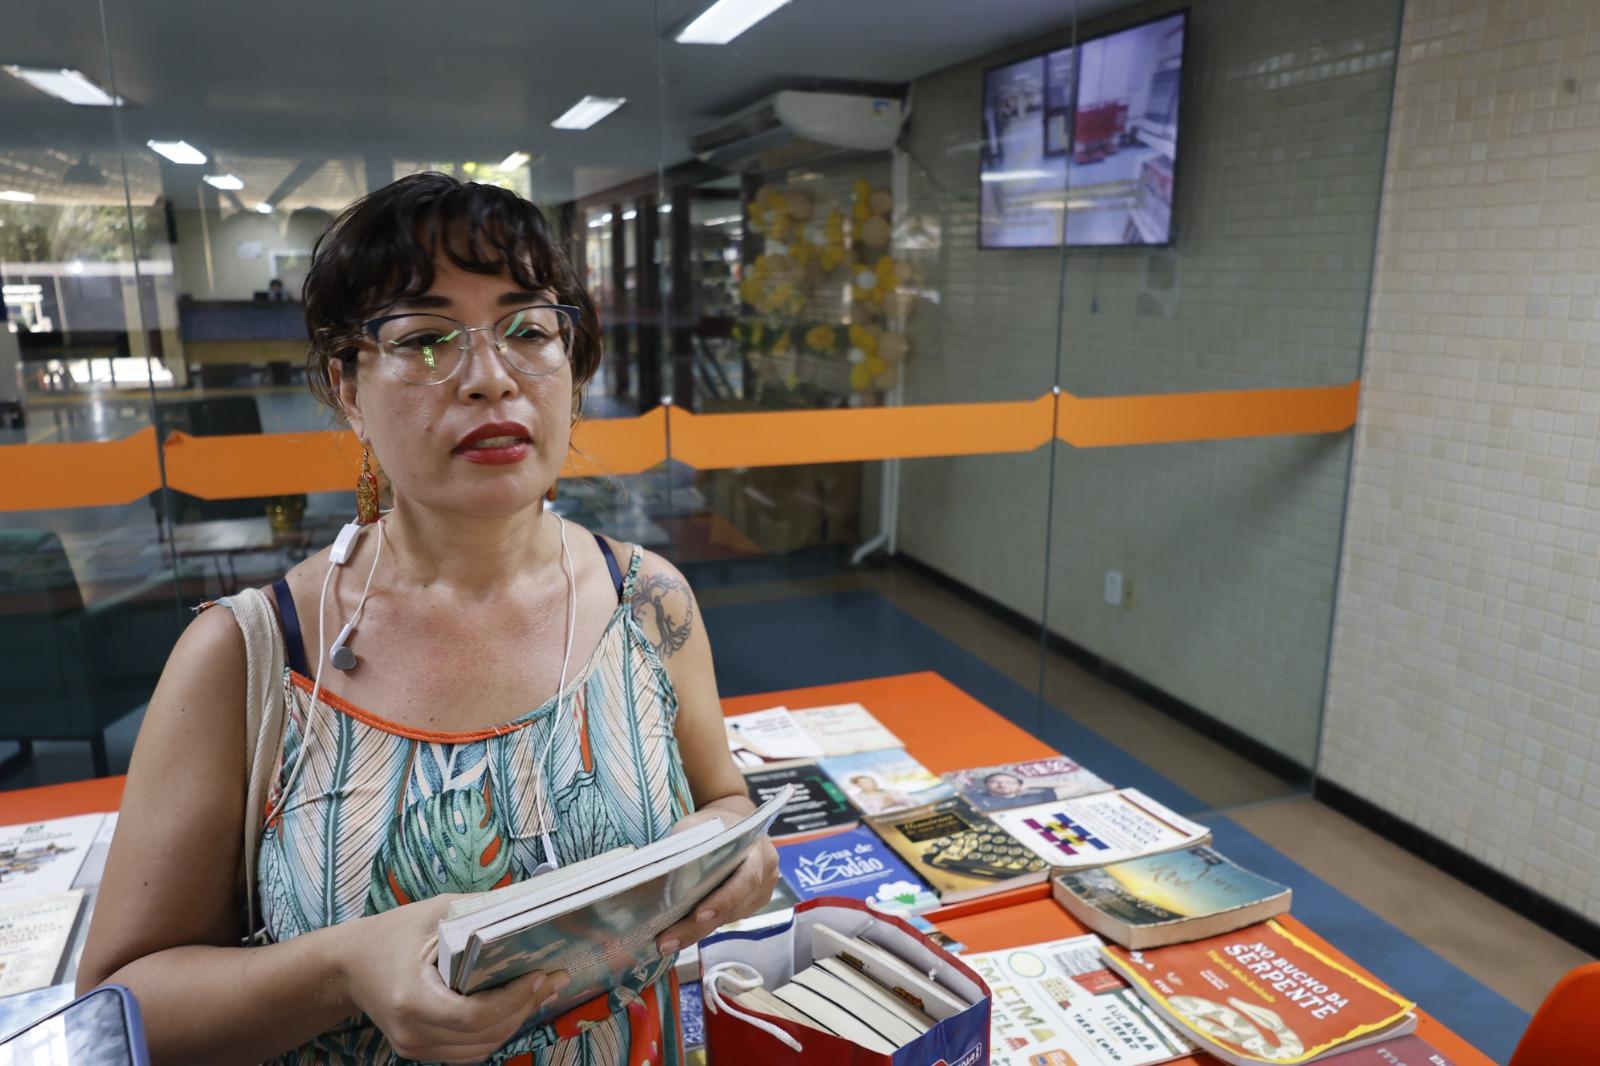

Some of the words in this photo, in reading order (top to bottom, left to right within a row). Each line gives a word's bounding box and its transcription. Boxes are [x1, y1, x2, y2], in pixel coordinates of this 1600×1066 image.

[1223, 943, 1339, 1020] SERPENTE
[1248, 942, 1276, 959] NO
[1272, 957, 1329, 994] BUCHO
[1325, 992, 1349, 1008] DA
[994, 985, 1056, 1042] CIMA
